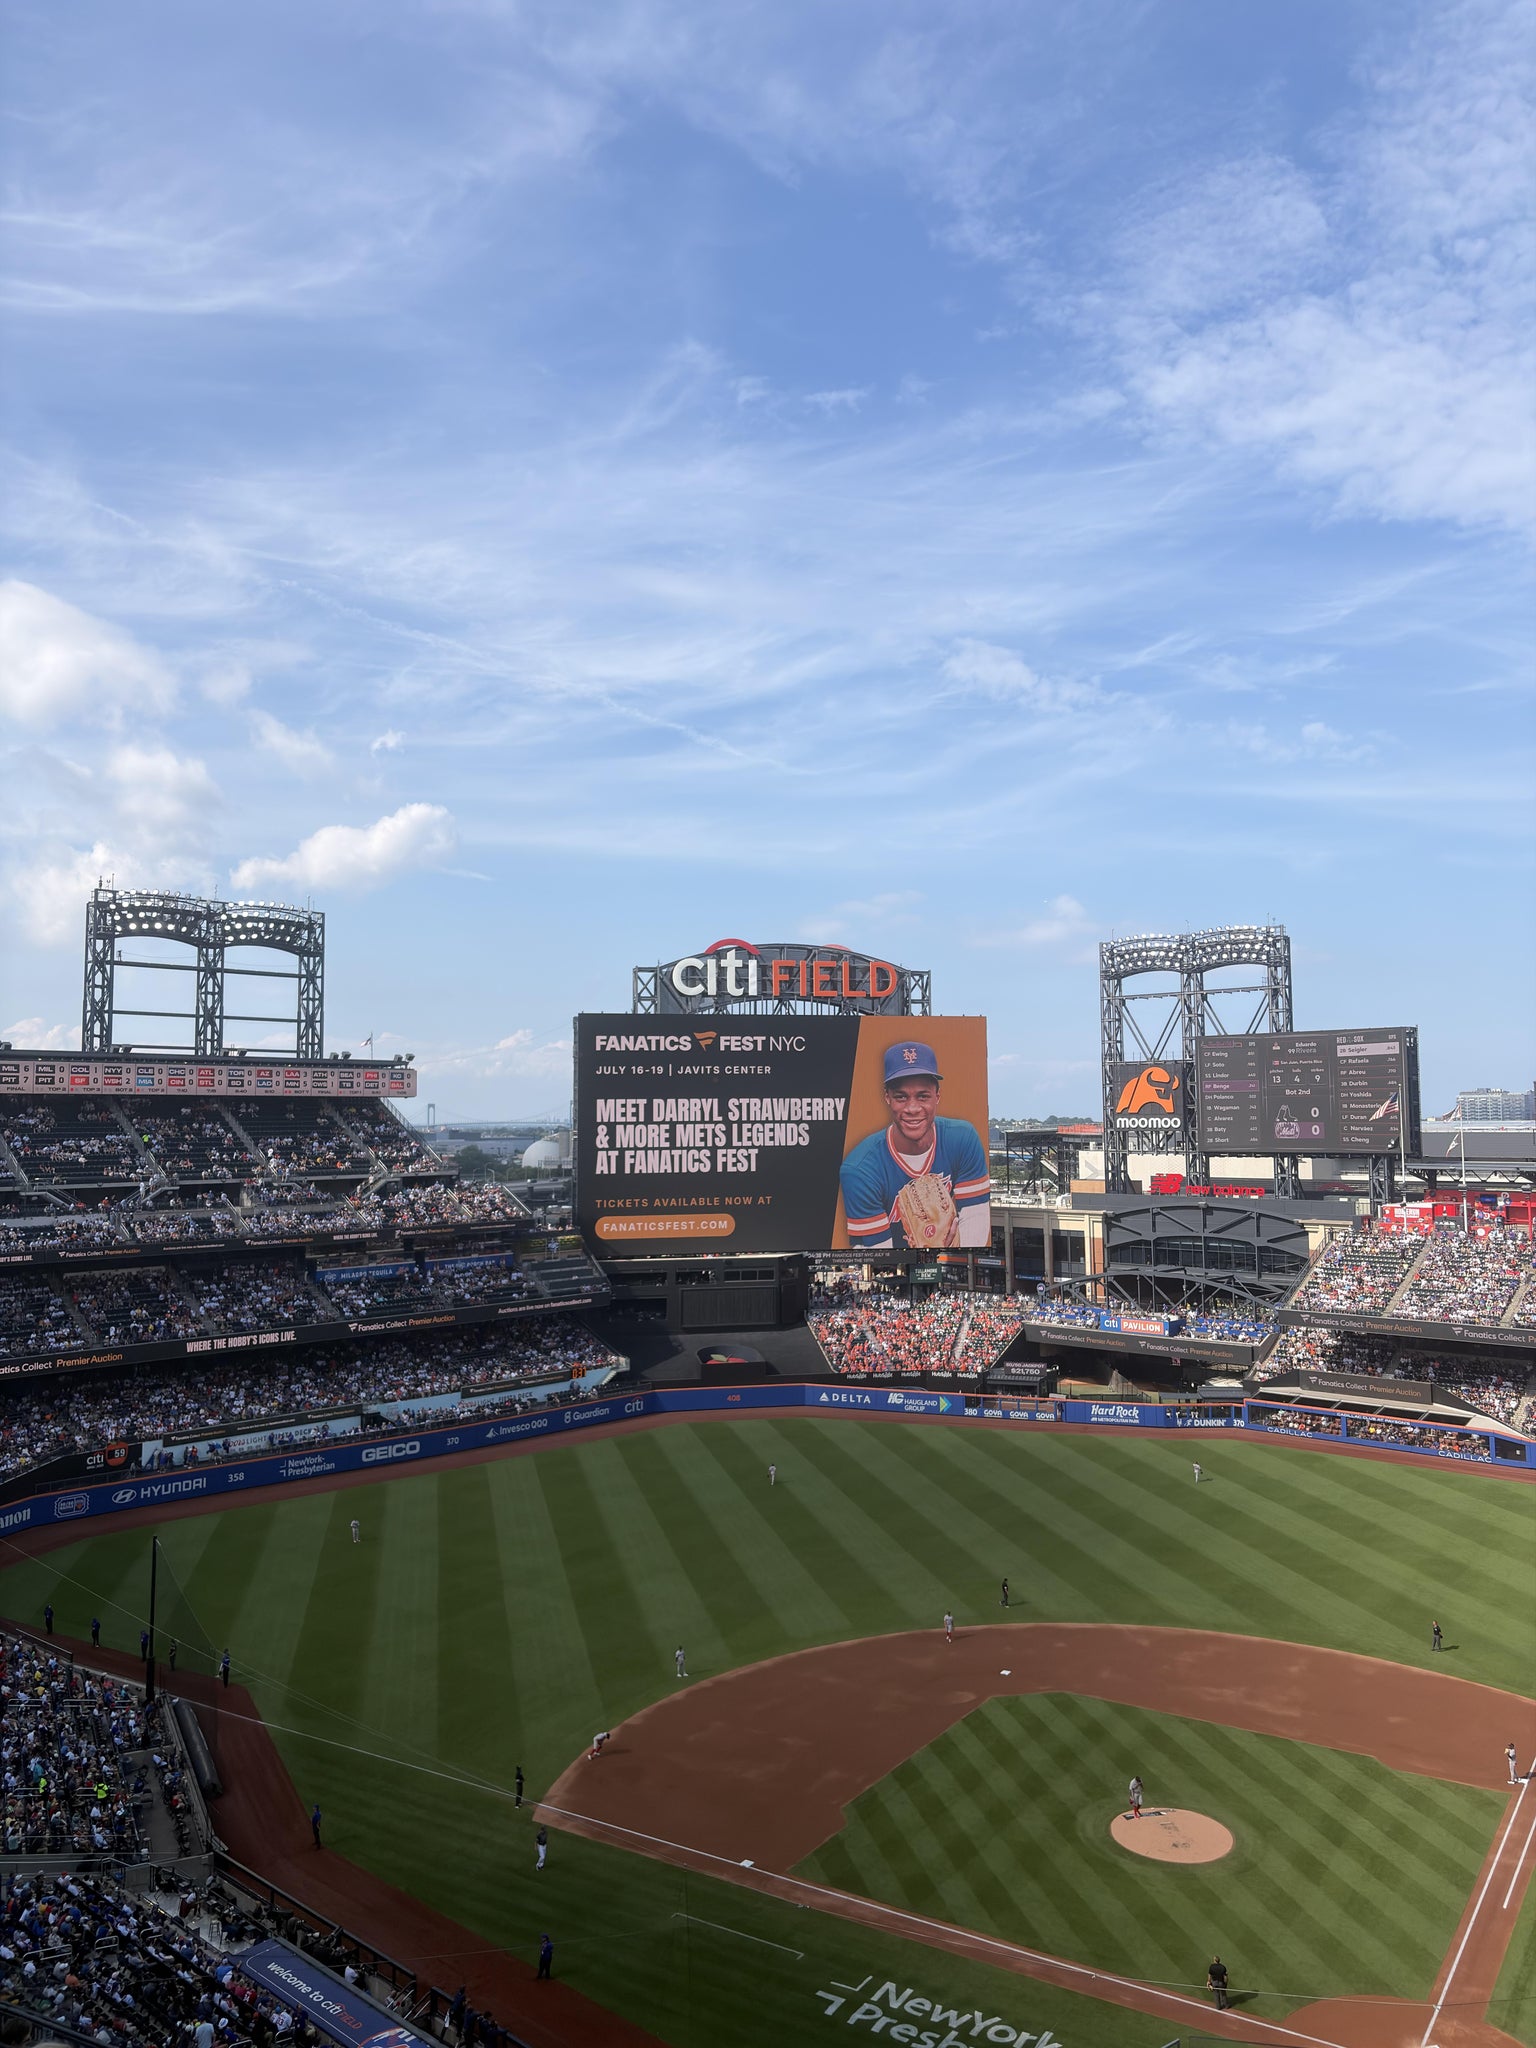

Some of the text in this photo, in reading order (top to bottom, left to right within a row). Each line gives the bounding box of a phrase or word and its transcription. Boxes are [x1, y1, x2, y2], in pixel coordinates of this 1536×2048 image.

[672, 948, 898, 998] citi FIELD
[595, 1035, 806, 1052] FANATICS FEST NYC
[1336, 1036, 1346, 1044] RED
[104, 1066, 122, 1074] NYY
[595, 1065, 772, 1075] JULY 16-19 JAVITS CENTER
[1272, 1074, 1321, 1083] 13 9
[596, 1097, 846, 1123] MEET DARRYL STRAWBERRY
[1311, 1107, 1320, 1118] 0
[1116, 1117, 1181, 1129] moomoo
[595, 1122, 810, 1149] & MORE METS LEGENDS
[1214, 1126, 1227, 1135] Baty
[1311, 1125, 1320, 1135] 0
[595, 1148, 759, 1174] AT FANATICS FEST
[1185, 1183, 1265, 1197] new balance
[595, 1196, 773, 1208] TICKETS AVAILABLE NOW AT
[603, 1220, 728, 1232] FANATICSFEST.COM
[358, 1314, 456, 1332] Fanatics Collect Premier Auction
[1123, 1321, 1161, 1333] PAVILION
[1310, 1316, 1423, 1334] Fanatics Collect Premier Auction
[186, 1330, 297, 1353] WHERE THE HOBBY'S ICONS LIVE.
[1047, 1332, 1126, 1347] Fanatics Collect Premier Auction
[1463, 1329, 1497, 1340] Fanatics
[1497, 1332, 1526, 1343] Collect
[1146, 1342, 1234, 1358] Fanatics Collect Premier Auction
[21, 1361, 53, 1373] Collect
[56, 1356, 90, 1368] Premier
[90, 1352, 123, 1364] Auction
[1318, 1377, 1422, 1398] Fanatics Collect Premier Auction
[832, 1393, 871, 1404] DELTA
[904, 1398, 938, 1407] HAUGLAND
[624, 1399, 644, 1413] citi
[904, 1404, 926, 1412] GROUP
[964, 1408, 978, 1416] 380
[1091, 1404, 1140, 1419] Hard Rock
[572, 1406, 610, 1421] Guardian
[983, 1409, 1003, 1417] GOYA
[1009, 1410, 1029, 1418] GOYA
[1035, 1412, 1055, 1420] GOYA
[499, 1418, 549, 1435] Invesco QQQ
[1193, 1418, 1227, 1427] DUNKIN'
[1232, 1418, 1245, 1427] 370
[1267, 1426, 1313, 1438] CADILLAC
[446, 1435, 460, 1446] 370
[361, 1440, 421, 1463] GEICO
[1438, 1450, 1492, 1463] CADILLAC
[86, 1454, 104, 1465] citi
[288, 1454, 325, 1468] NewYork-
[287, 1462, 335, 1477] Presbyterian
[228, 1472, 245, 1483] 358
[140, 1477, 207, 1500] HYUNDAI
[266, 1961, 312, 1993] welcome
[309, 1990, 325, 2003] to
[336, 2010, 363, 2030] FIELD
